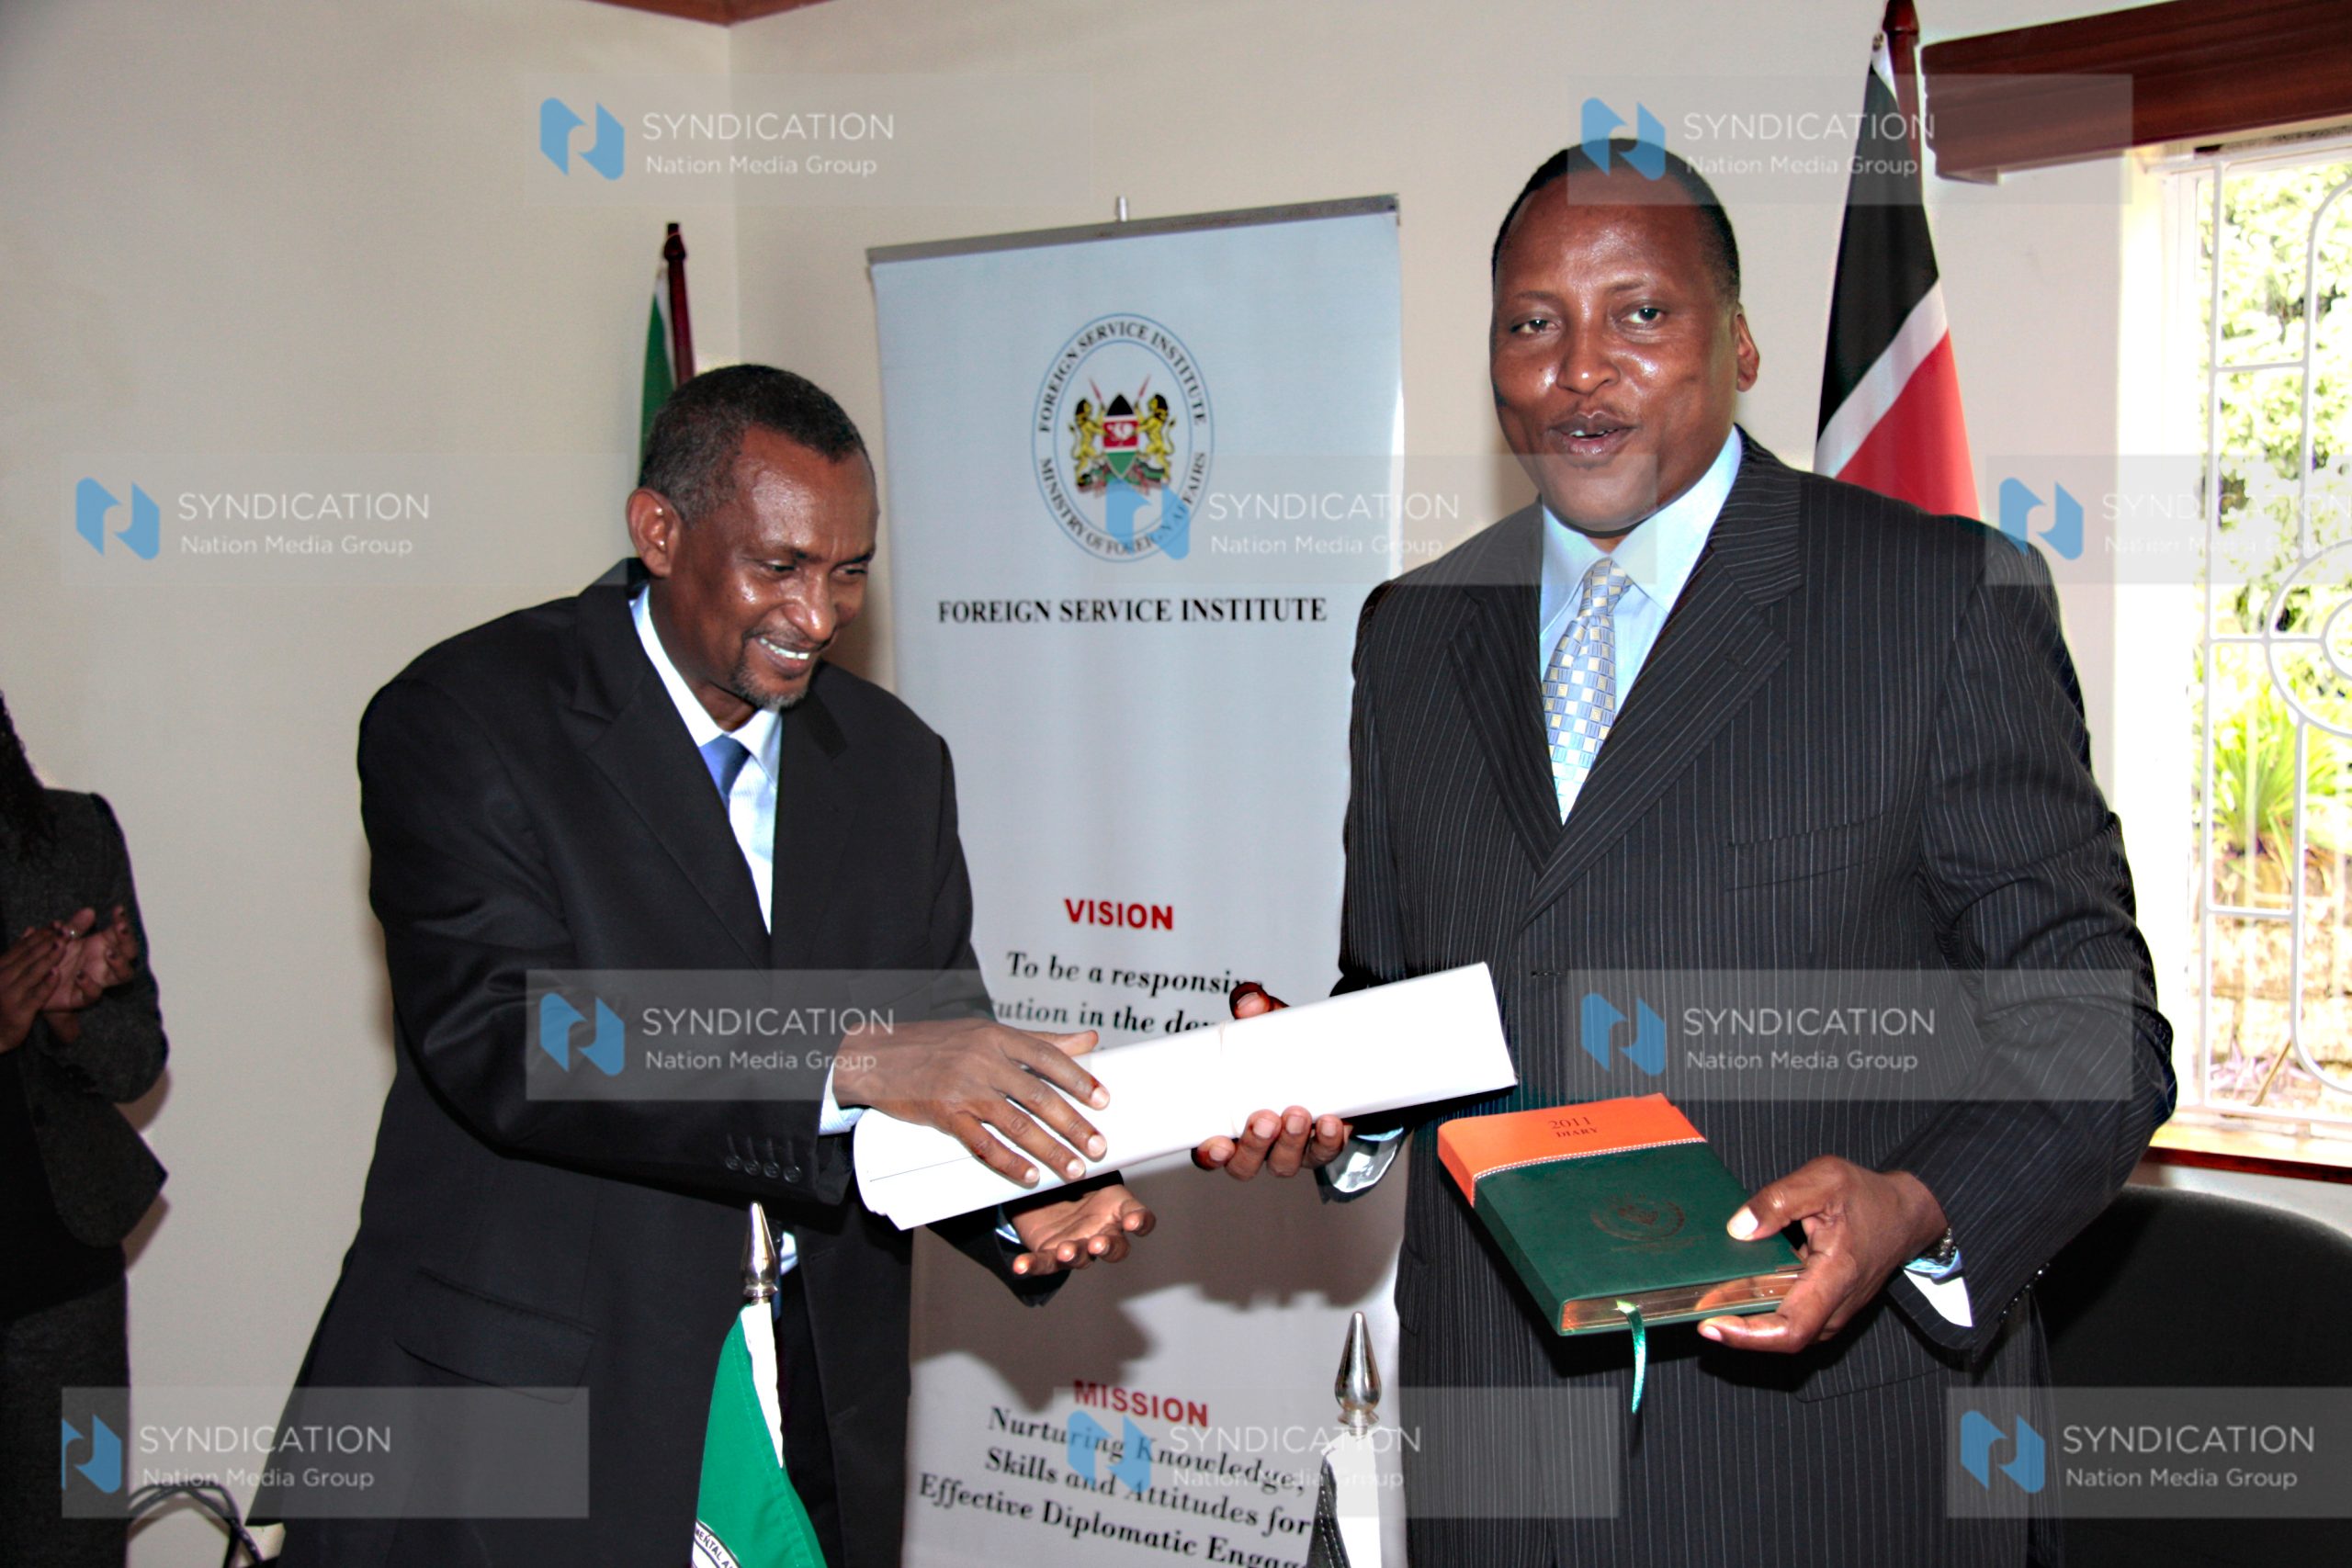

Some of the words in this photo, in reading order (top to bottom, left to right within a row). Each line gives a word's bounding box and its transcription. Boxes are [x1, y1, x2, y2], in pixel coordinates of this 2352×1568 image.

[1039, 351, 1080, 433] FOREIGN
[1079, 321, 1148, 352] SERVICE
[1151, 332, 1207, 425] INSTITUTE
[1040, 457, 1086, 537] MINISTRY
[939, 600, 1051, 623] FOREIGN
[1059, 598, 1171, 623] SERVICE
[1182, 597, 1328, 622] INSTITUTE
[1064, 897, 1174, 930] VISION
[1007, 951, 1038, 977] To
[1048, 955, 1080, 981] be
[1089, 967, 1103, 983] a
[1111, 969, 1263, 998] responsi
[1080, 1001, 1104, 1026] in
[1113, 1006, 1155, 1033] the
[1548, 1116, 1591, 1130] 2011
[1556, 1127, 1598, 1138] DIARY
[1073, 1380, 1208, 1427] MISSION
[989, 1405, 1125, 1462] Nurturing
[1136, 1436, 1305, 1496] Knowledge,
[920, 1472, 1035, 1518] Effective
[1042, 1499, 1198, 1555] Diplomatic
[986, 1447, 1058, 1483] Skills
[1065, 1471, 1118, 1495] and
[1125, 1480, 1259, 1526] Attitudes
[1261, 1506, 1312, 1538] for
